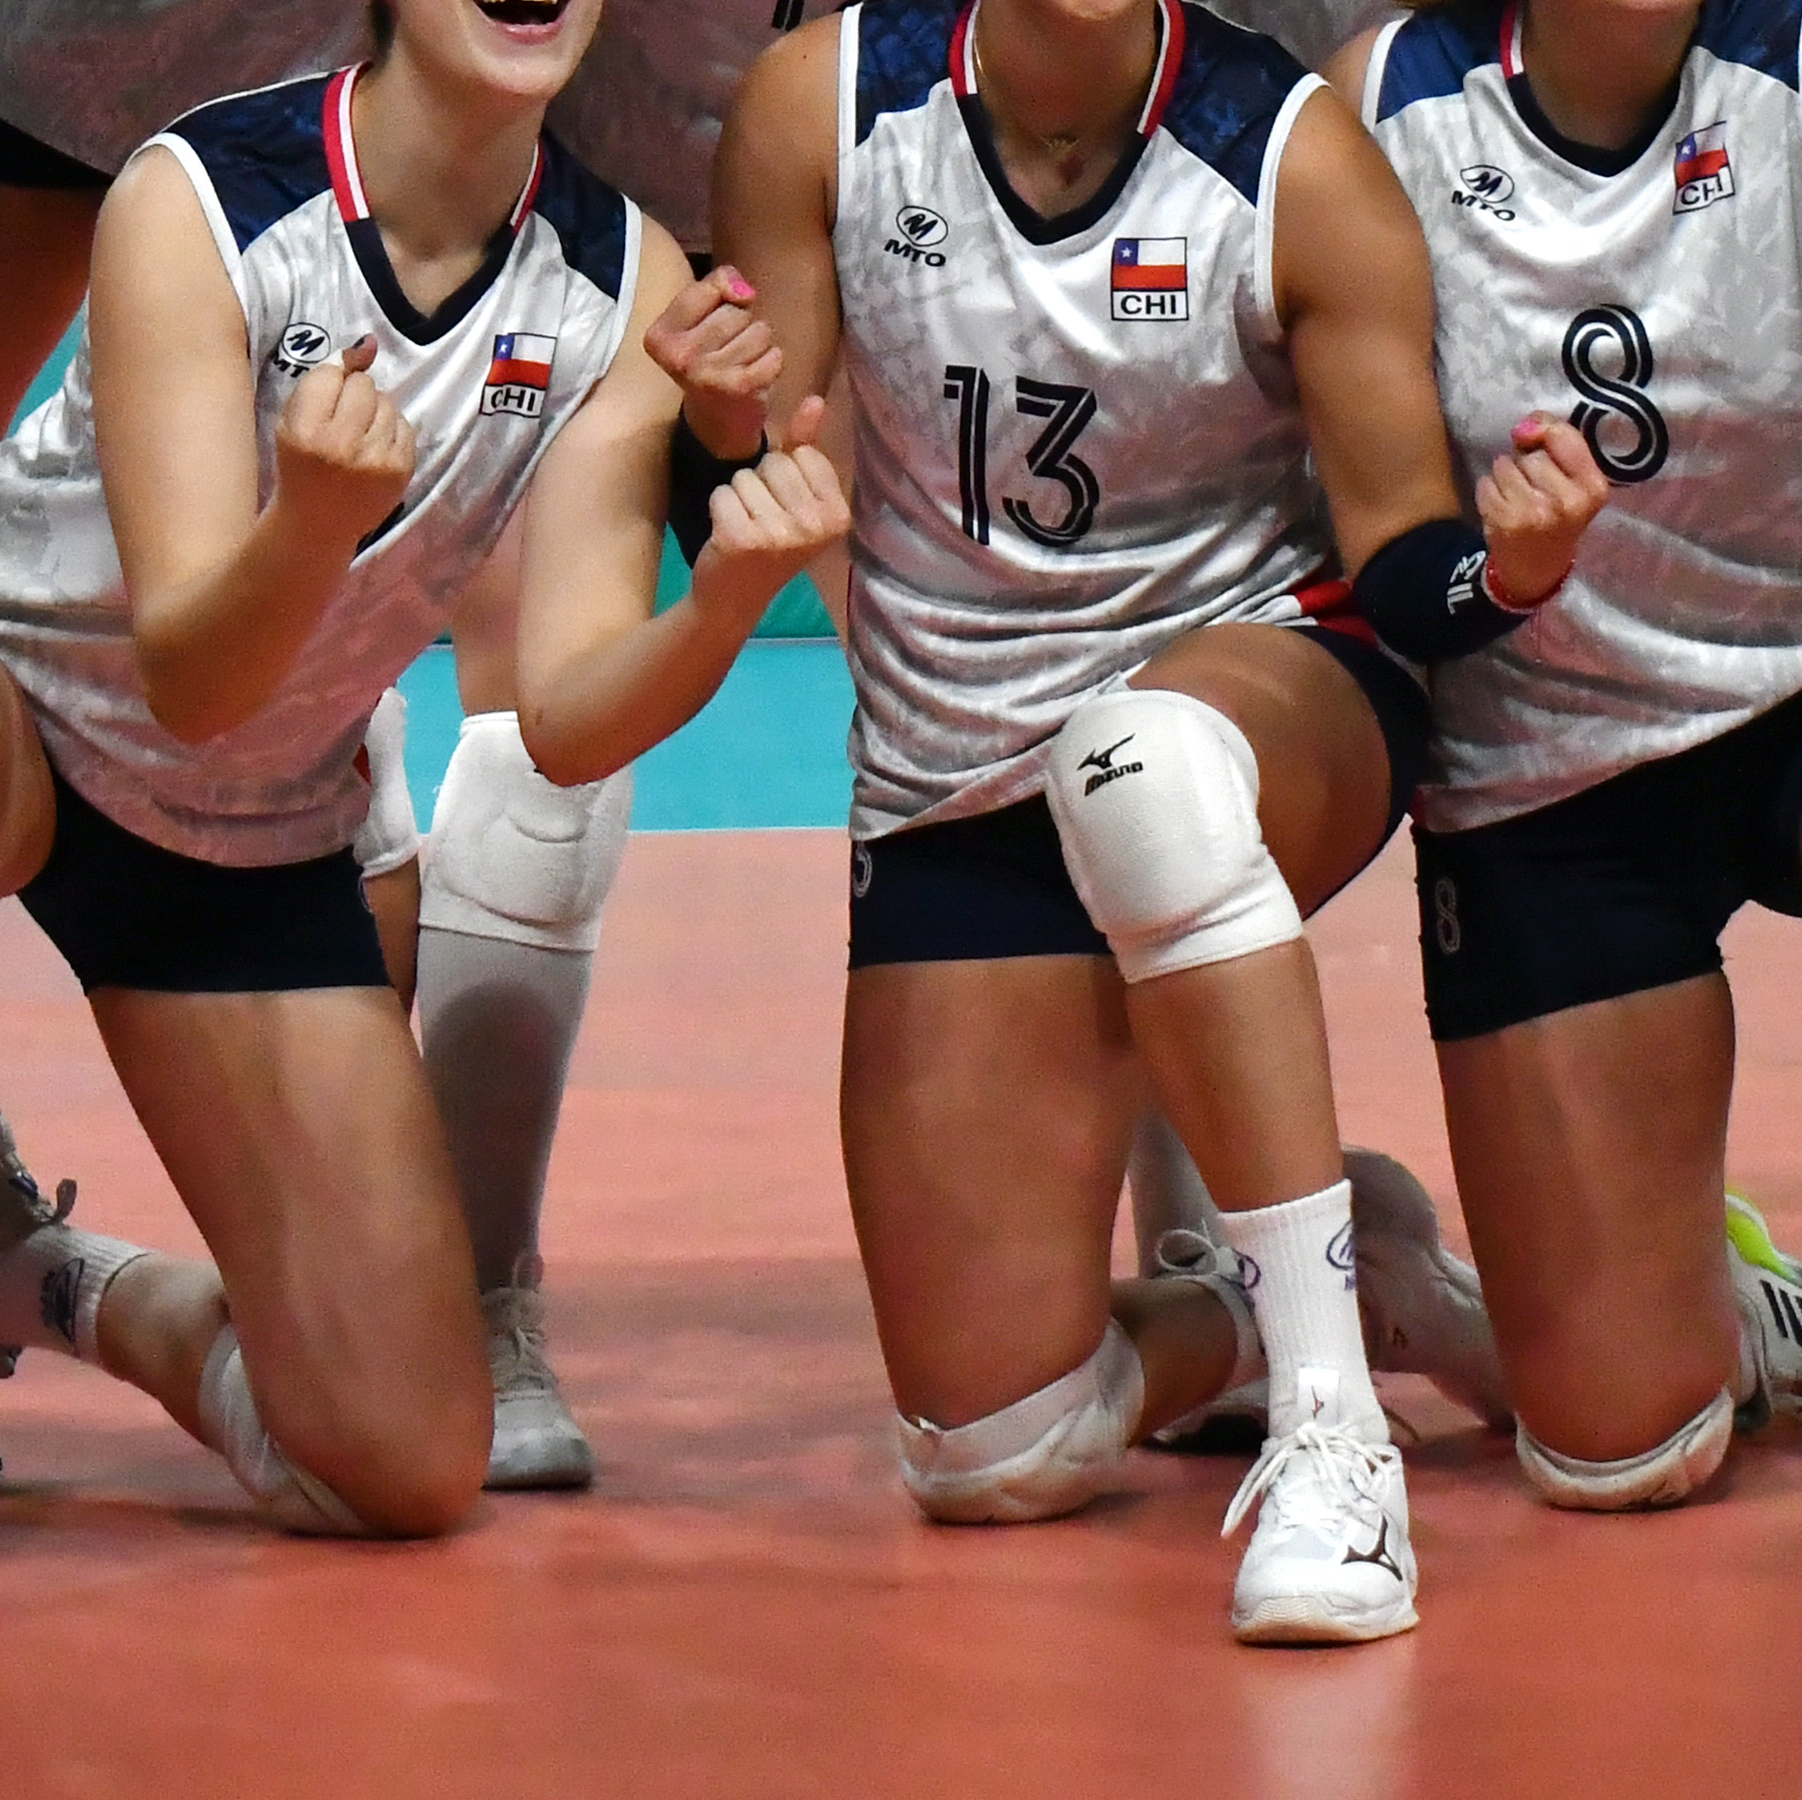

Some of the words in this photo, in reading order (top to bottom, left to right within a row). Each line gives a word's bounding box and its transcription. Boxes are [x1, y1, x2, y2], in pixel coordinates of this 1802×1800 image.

[1451, 190, 1515, 221] MTO
[884, 239, 946, 267] MTO
[1121, 294, 1177, 315] CHI
[273, 357, 310, 378] MT
[491, 387, 536, 411] CHI
[1562, 303, 1669, 485] 8
[944, 365, 1099, 547] 13
[1434, 879, 1459, 955] 8
